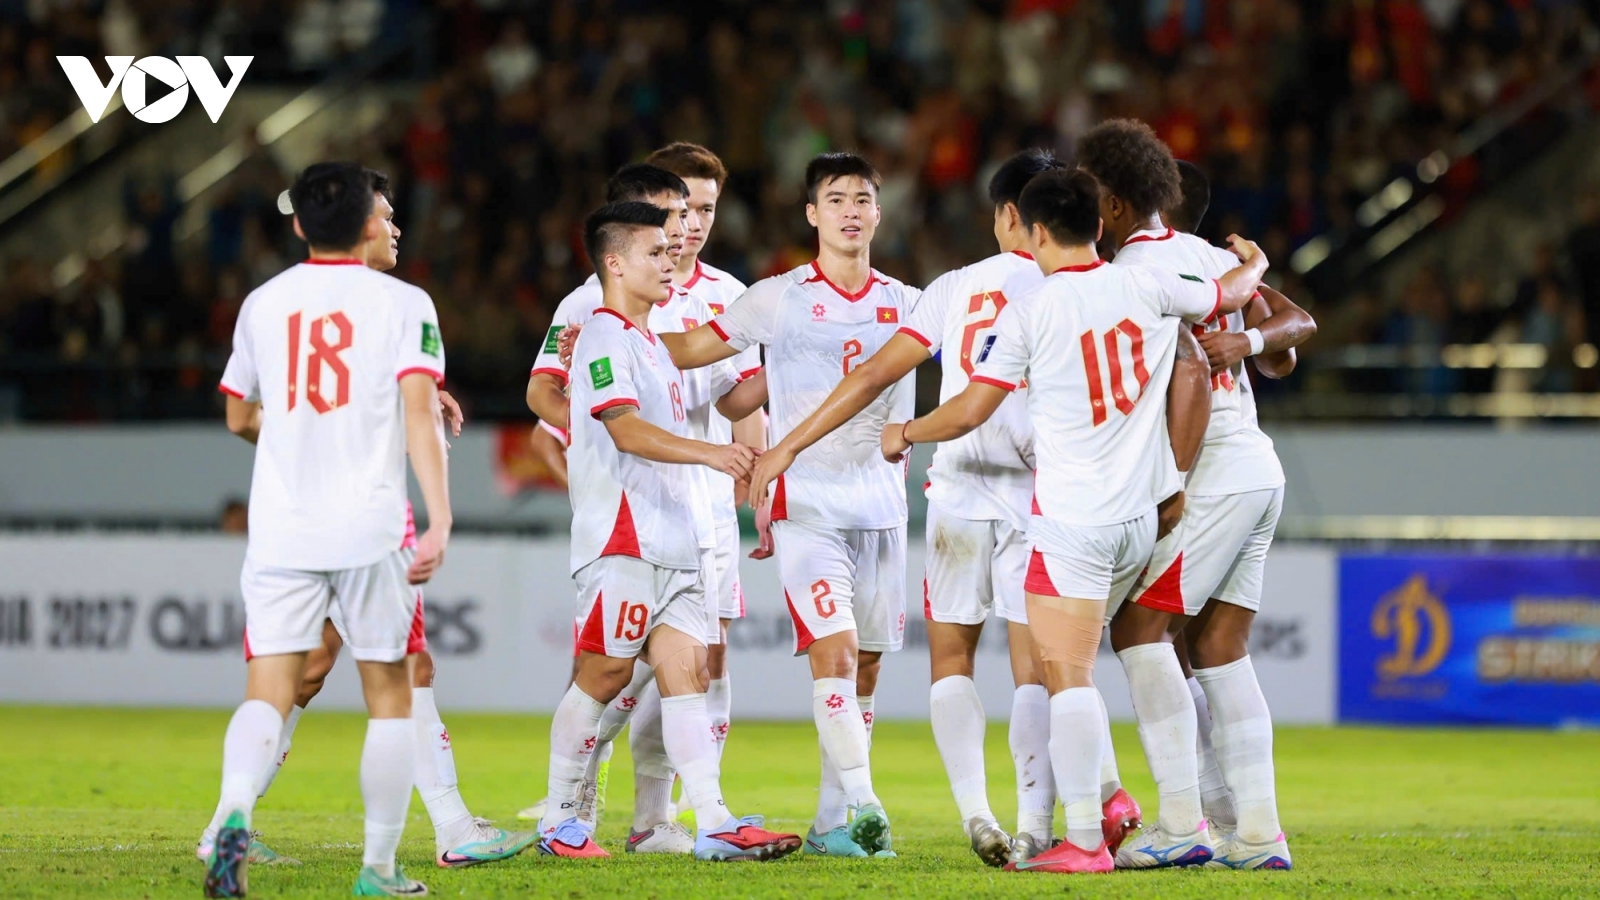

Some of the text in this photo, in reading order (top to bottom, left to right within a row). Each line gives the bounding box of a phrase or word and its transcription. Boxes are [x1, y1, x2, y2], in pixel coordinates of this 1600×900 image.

[287, 310, 354, 415] 18
[843, 338, 862, 377] 2
[1080, 318, 1150, 428] 10
[667, 381, 685, 422] 19
[810, 579, 837, 619] 2
[614, 600, 649, 642] 19
